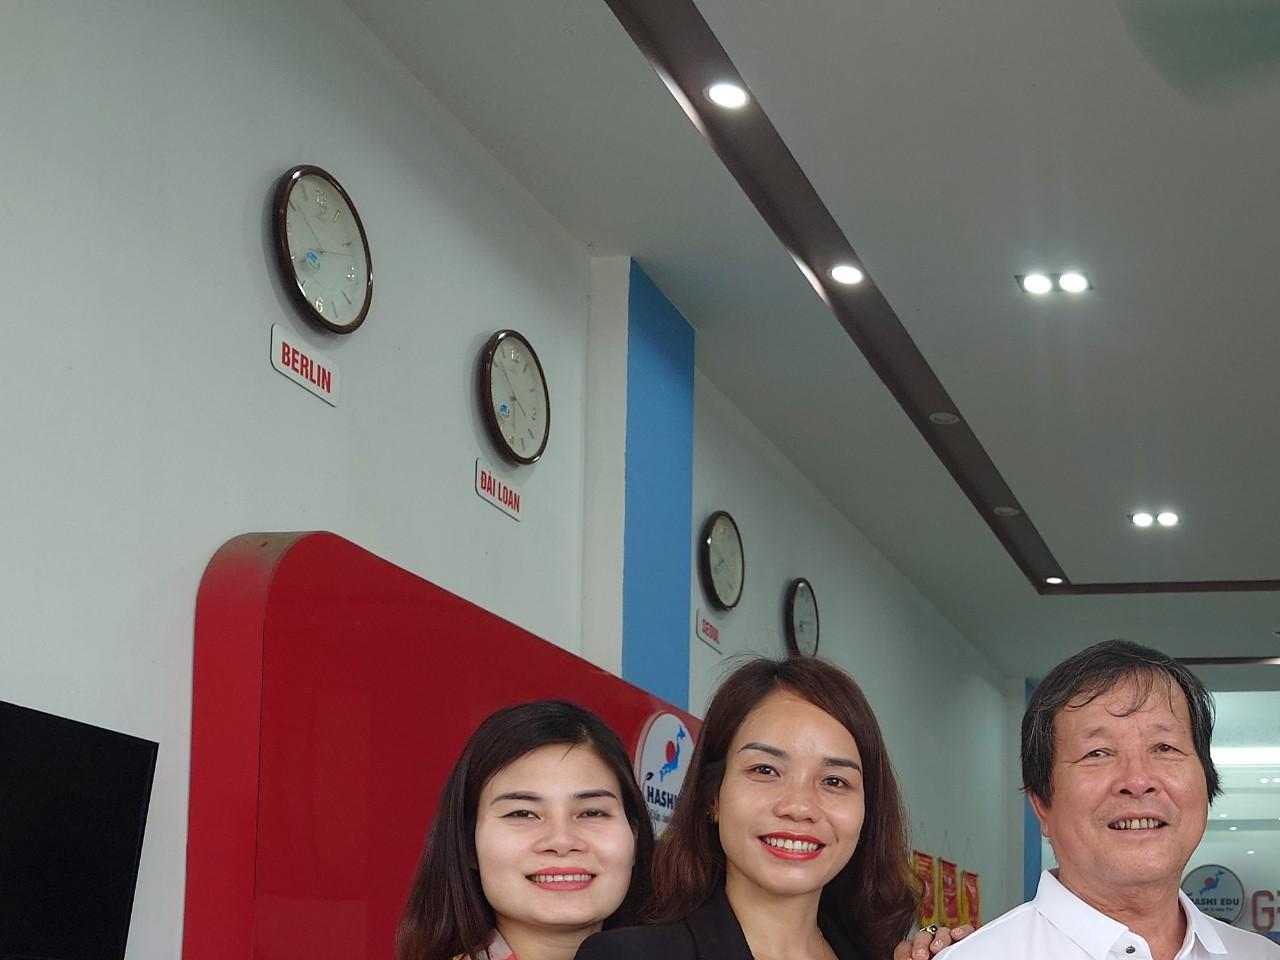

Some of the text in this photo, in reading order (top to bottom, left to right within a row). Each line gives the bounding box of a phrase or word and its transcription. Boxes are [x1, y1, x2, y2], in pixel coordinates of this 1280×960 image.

[281, 341, 332, 393] BERLIN
[480, 470, 520, 513] ĐÀI LOAN
[1191, 897, 1240, 906] ASHI EDU
